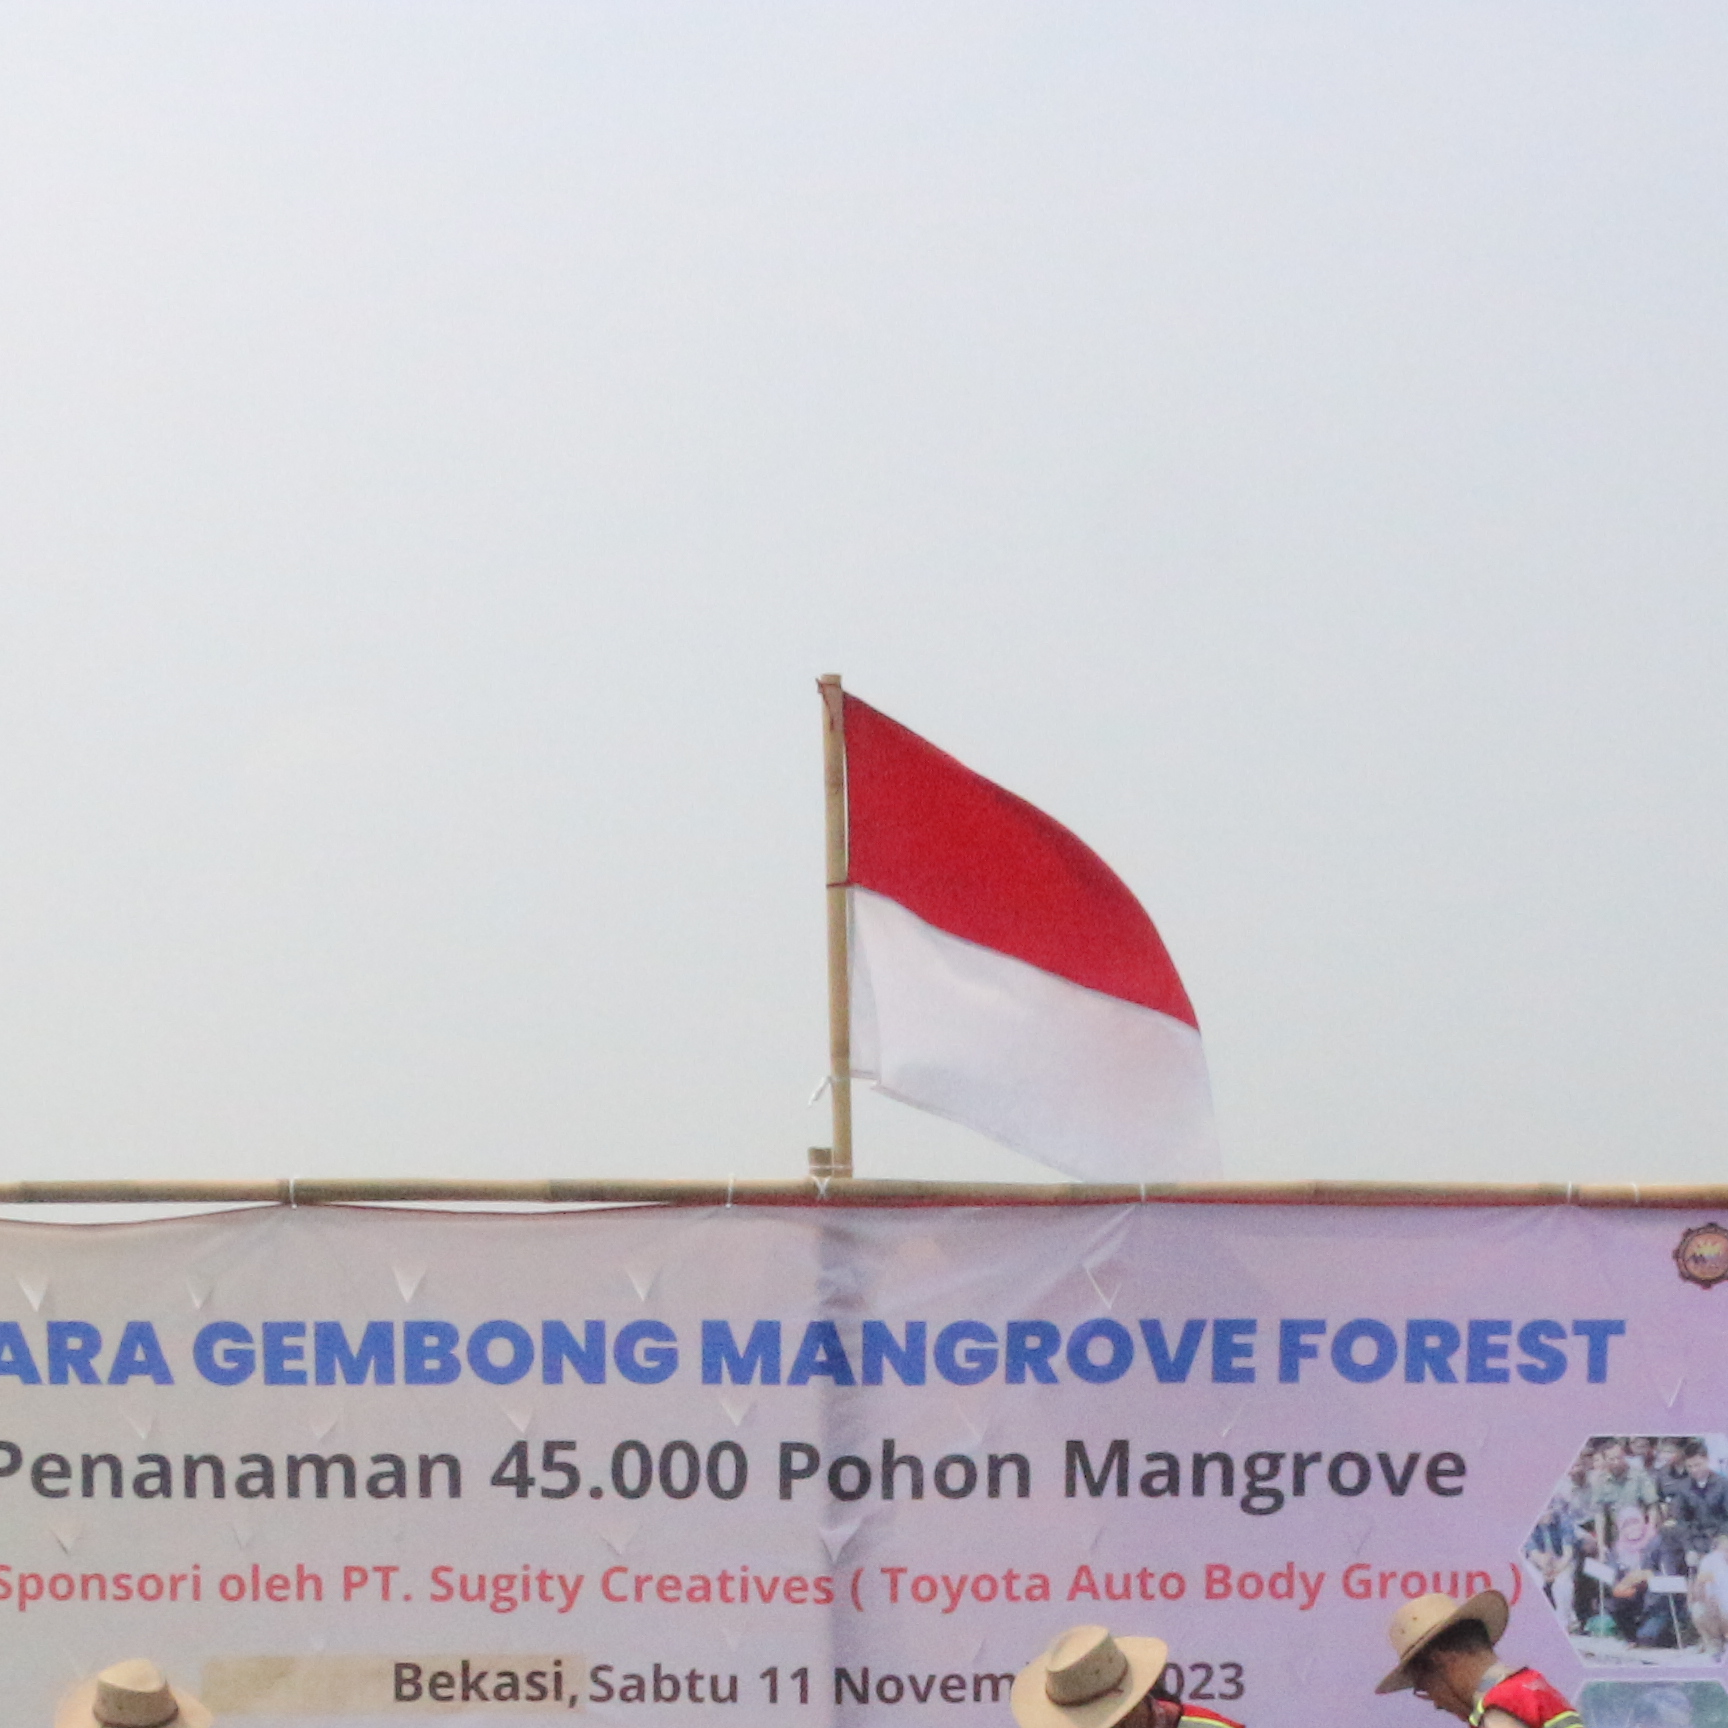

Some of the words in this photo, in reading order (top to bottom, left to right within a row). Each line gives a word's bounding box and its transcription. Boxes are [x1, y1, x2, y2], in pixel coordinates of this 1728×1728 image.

[194, 1319, 678, 1386] GEMBONG
[702, 1318, 1257, 1386] MANGROVE
[1279, 1318, 1626, 1384] FOREST
[489, 1439, 749, 1501] 45.000
[778, 1438, 1032, 1503] Pohon
[1064, 1439, 1468, 1517] Mangrove
[218, 1563, 324, 1603] oleh
[342, 1564, 412, 1602] PT.
[430, 1564, 584, 1614] Sugity
[600, 1564, 836, 1606] Creatives
[881, 1566, 1052, 1614] Toyota
[1067, 1563, 1188, 1602] Auto
[1204, 1561, 1327, 1611] Body
[759, 1666, 809, 1705] 11
[832, 1665, 1014, 1706] Novem
[1158, 1661, 1246, 1704] 023
